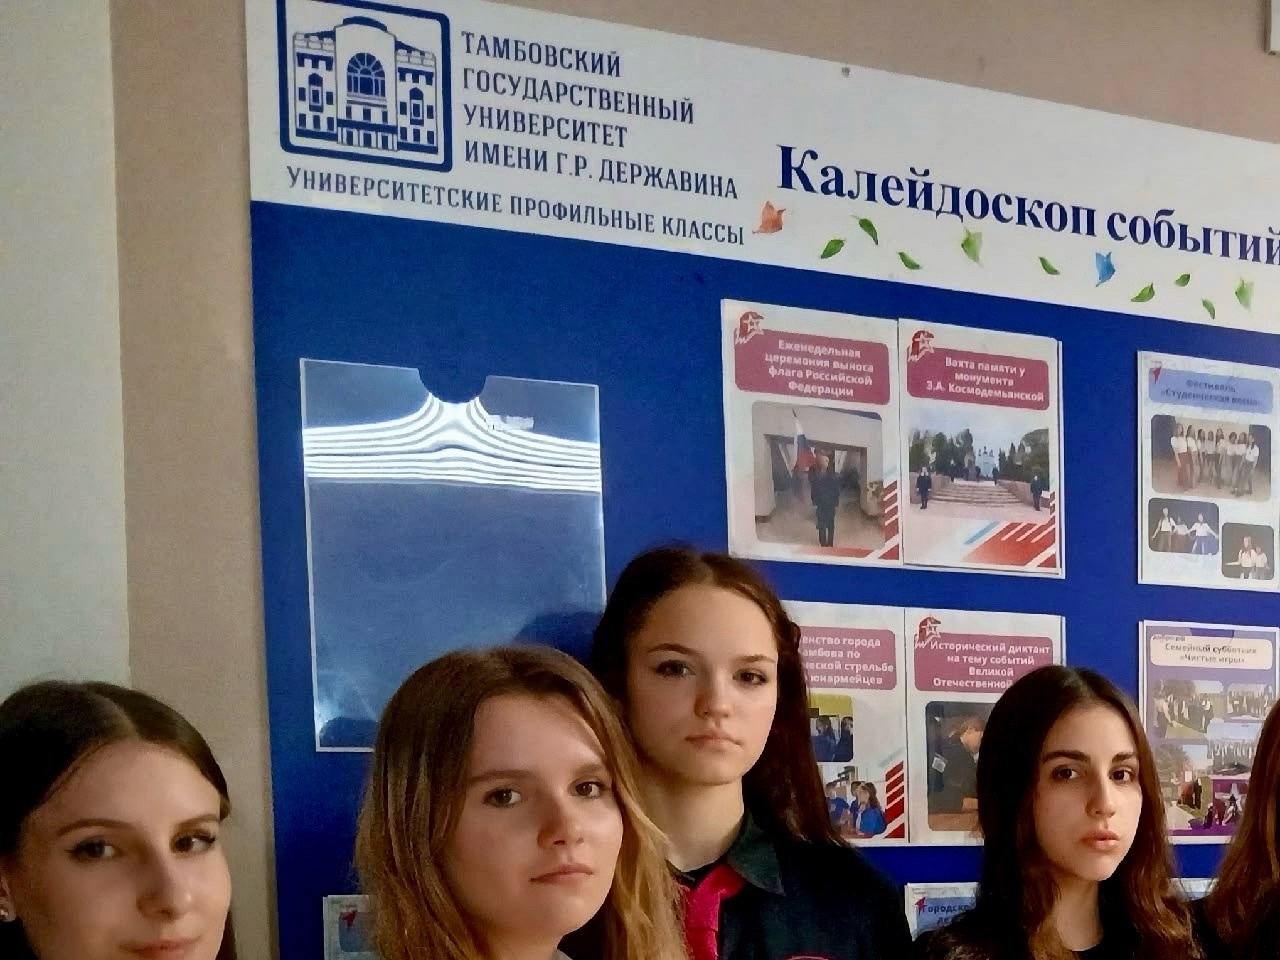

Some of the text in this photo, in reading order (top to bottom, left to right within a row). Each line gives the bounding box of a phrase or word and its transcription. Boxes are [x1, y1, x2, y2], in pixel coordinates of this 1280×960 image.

[461, 31, 621, 78] ТАМБОВСКИЙ
[463, 68, 694, 125] ГОСУДАРСТВЕННЫЙ
[464, 104, 628, 149] УНИВЕРСИТЕТ
[464, 140, 738, 199] ИМЕНИ Г.Р. ДЕРЖАВИНА
[777, 144, 1096, 237] Калейдоскоп
[287, 165, 744, 246] УНИВЕРСИТЕТСКИЕ ПРОФИЛЬНЫЕ КЛАССЫ
[778, 339, 861, 359] Еженедельная
[764, 353, 874, 373] церемония выноса
[945, 357, 975, 370] Вахта
[977, 363, 1017, 375] памяти
[768, 365, 873, 386] флага Российской
[954, 372, 1014, 386] монумента
[788, 381, 854, 397] Федерации
[948, 383, 1044, 402] Космодемьянской
[800, 635, 881, 649] енство города
[930, 640, 1050, 655] Исторический диктант
[800, 647, 861, 659] амбова по
[947, 655, 1035, 666] на тему событий
[844, 662, 894, 674] стрельбе
[968, 666, 1014, 677] Великой
[810, 673, 883, 686] юнармейцев
[933, 677, 1013, 690] Отечественной
